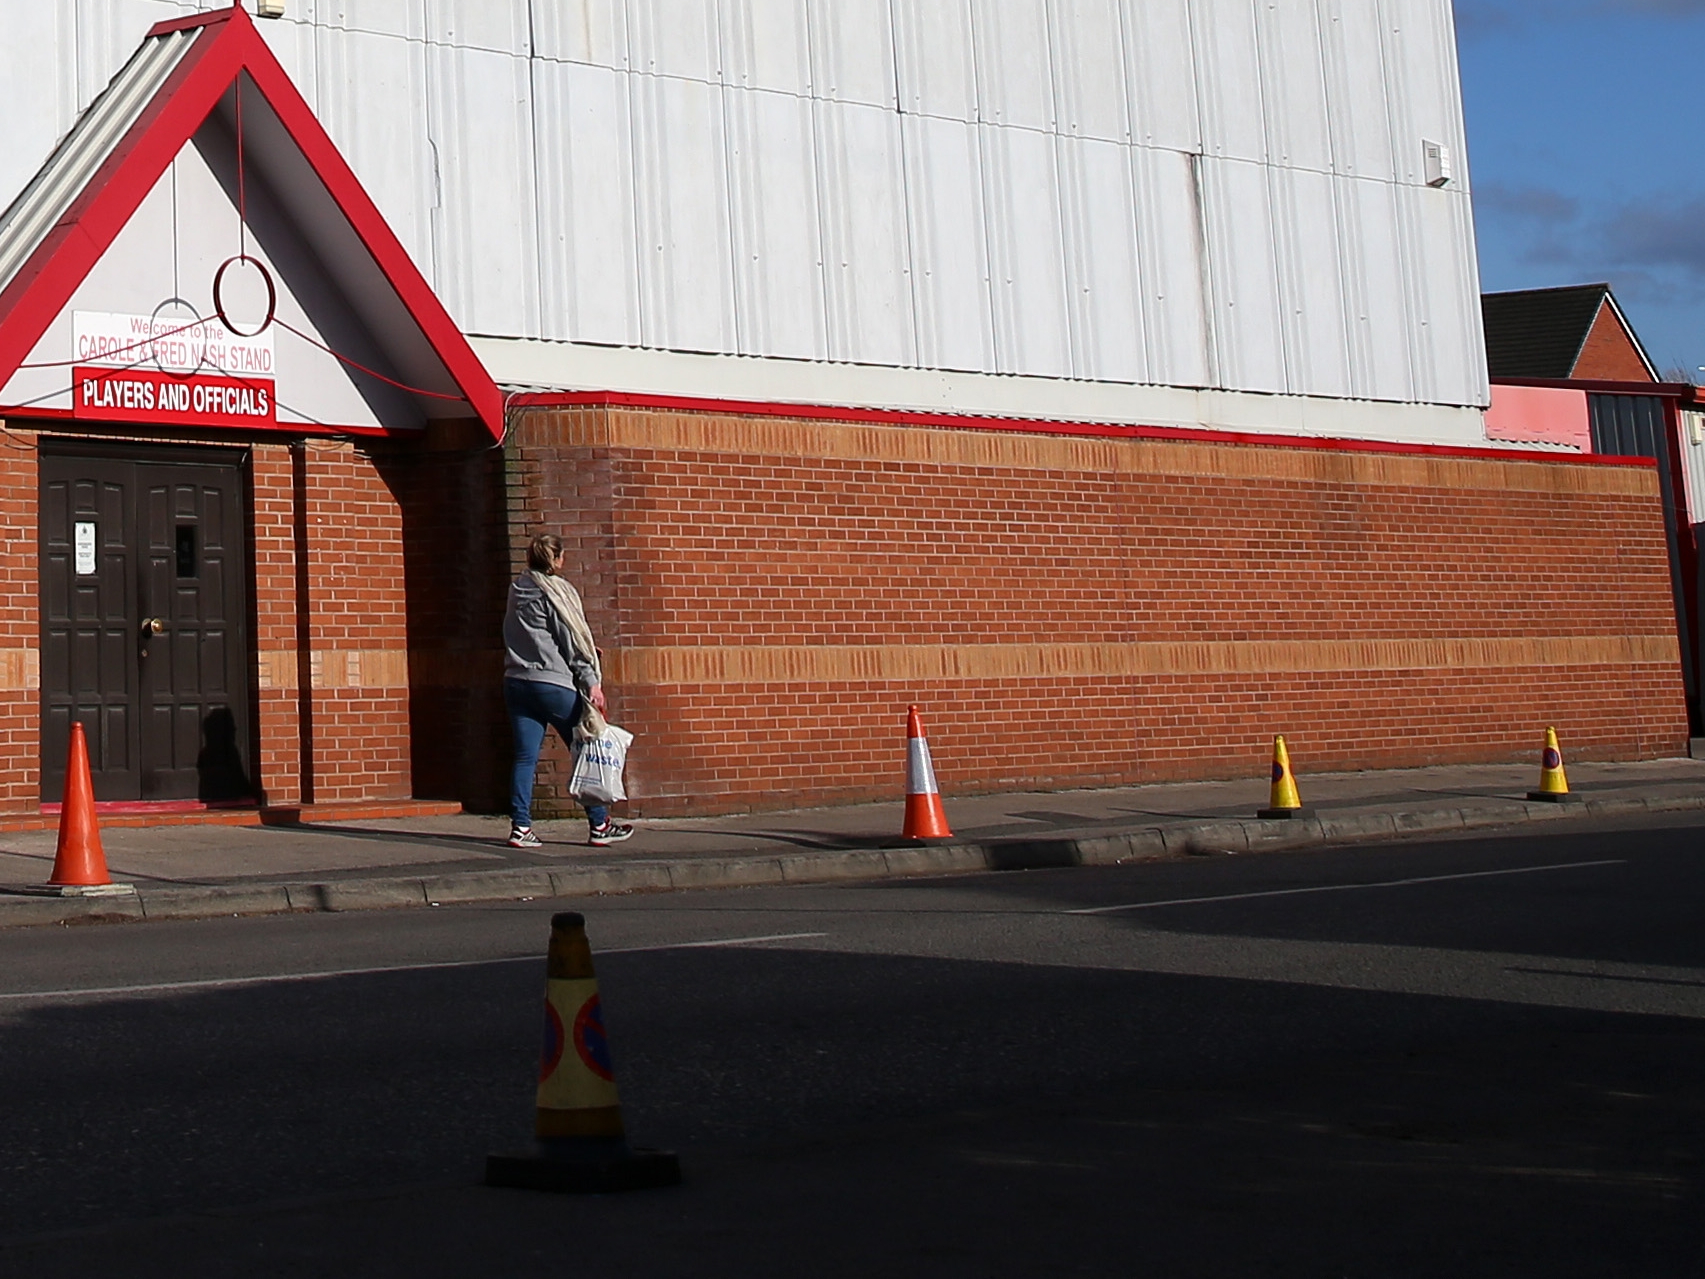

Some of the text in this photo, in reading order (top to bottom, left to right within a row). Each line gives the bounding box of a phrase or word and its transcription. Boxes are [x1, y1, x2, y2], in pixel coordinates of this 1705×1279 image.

[130, 317, 224, 340] Welcome to the
[79, 334, 272, 372] CAROLE & FRED NASH STAND
[83, 377, 270, 418] PLAYERS AND OFFICIALS
